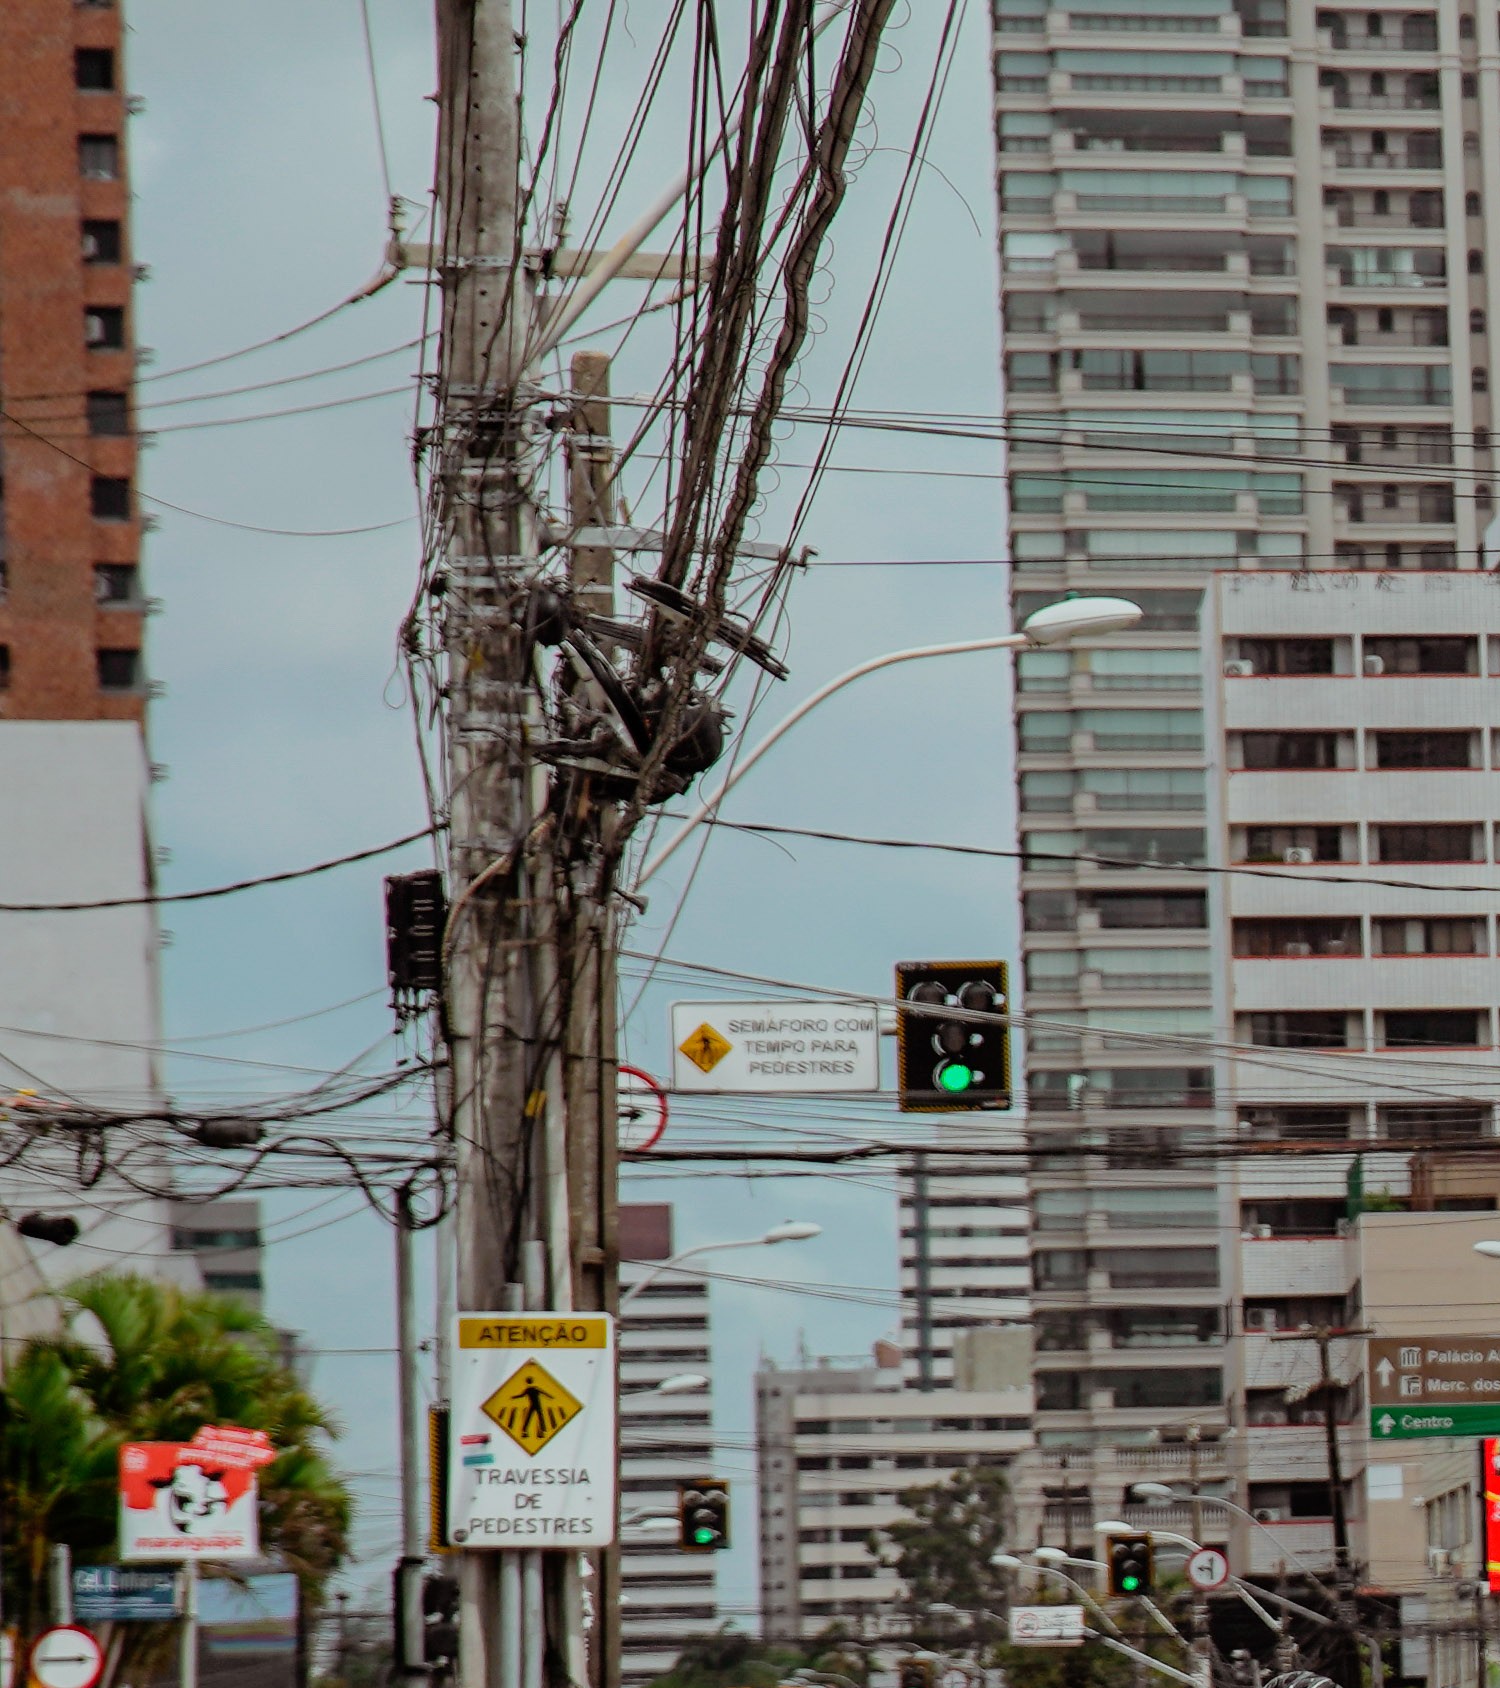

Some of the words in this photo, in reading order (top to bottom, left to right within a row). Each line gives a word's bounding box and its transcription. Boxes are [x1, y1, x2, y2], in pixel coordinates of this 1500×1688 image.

[728, 1017, 828, 1033] SEMÁFORO
[834, 1019, 874, 1032] COM
[744, 1040, 804, 1053] TEMPO
[811, 1040, 858, 1055] PARA
[749, 1060, 855, 1074] PEDESTRES
[480, 1322, 587, 1346] ATENÇÃO
[1427, 1347, 1483, 1364] Palácio
[1427, 1377, 1468, 1392] Merc.
[1401, 1413, 1454, 1429] Centro
[475, 1468, 591, 1485] TRAVESSIA
[515, 1493, 543, 1510] DE
[470, 1517, 593, 1534] PEDESTRES
